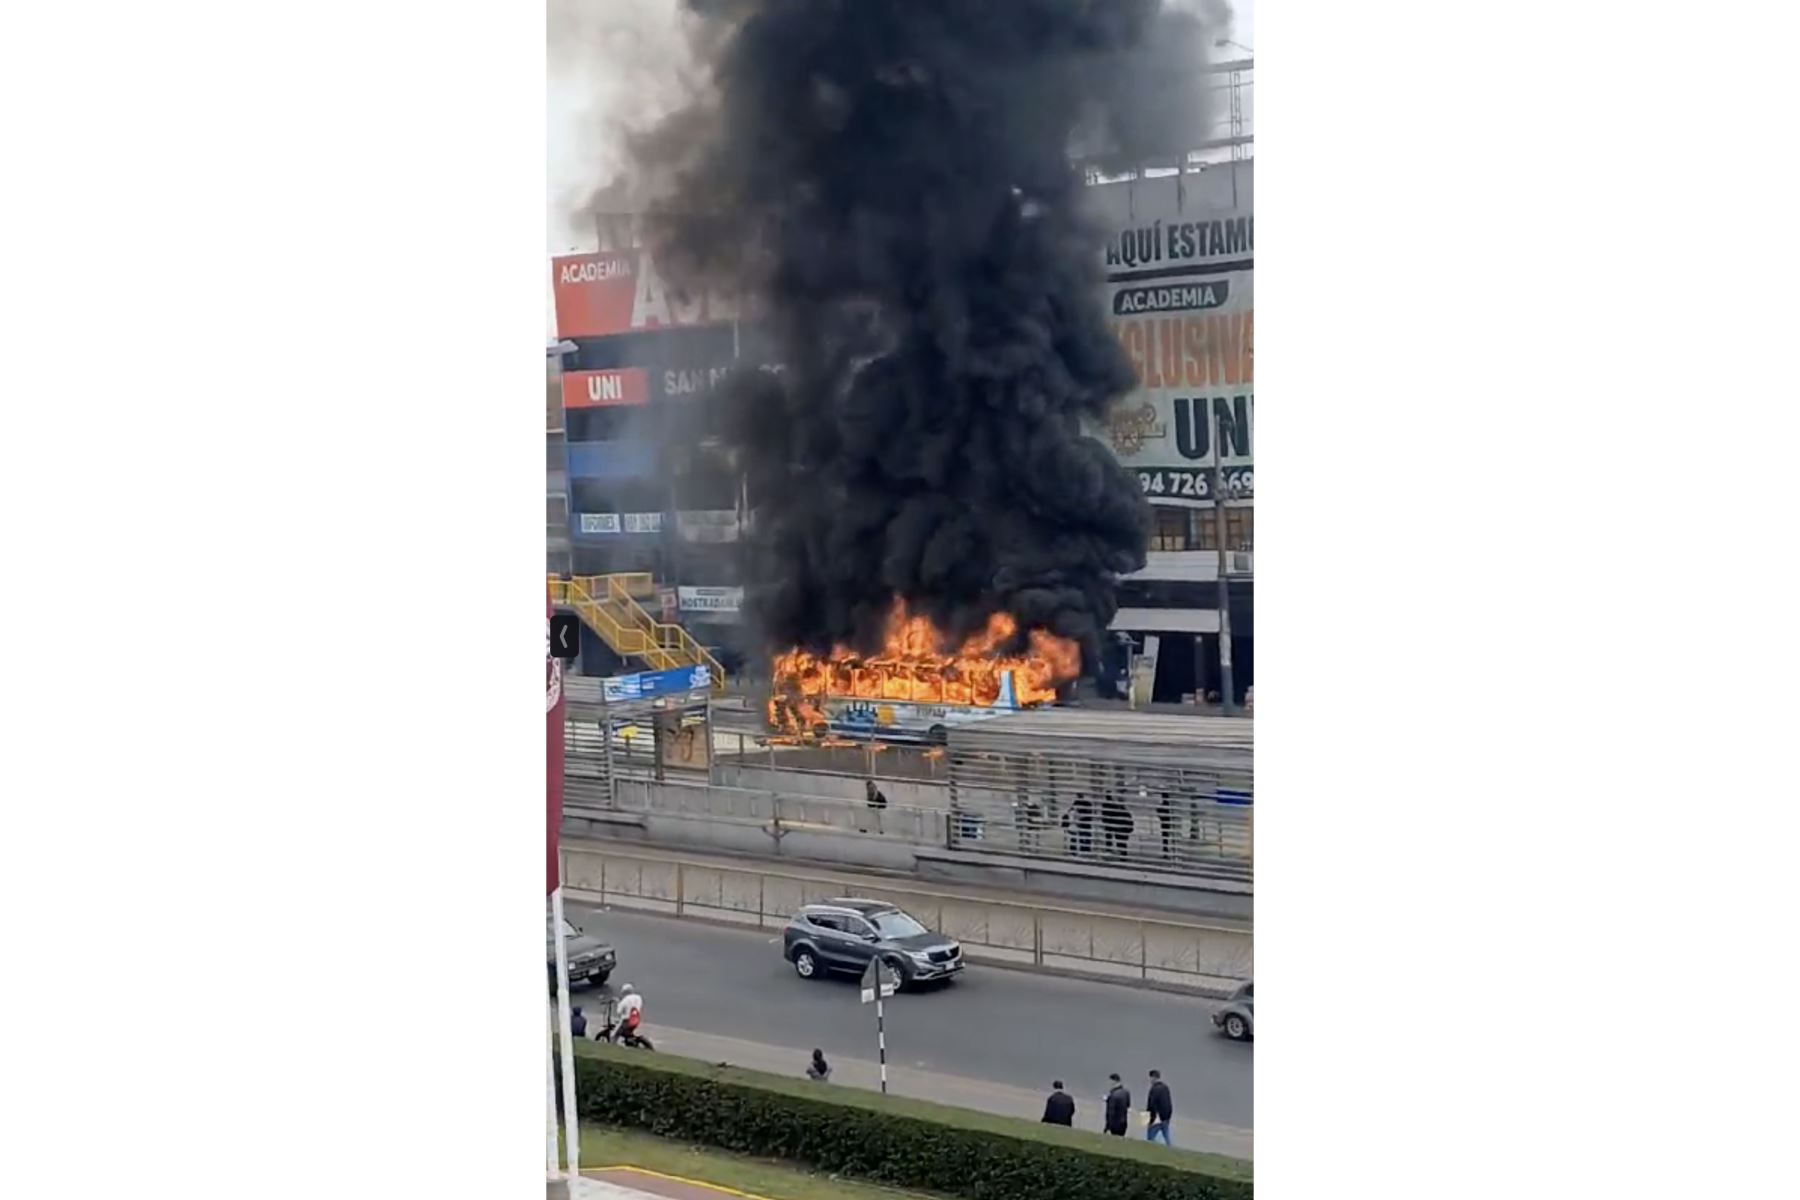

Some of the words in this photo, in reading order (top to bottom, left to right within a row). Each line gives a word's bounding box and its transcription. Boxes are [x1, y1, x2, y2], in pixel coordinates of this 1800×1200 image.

[1106, 219, 1161, 267] AQUÍ
[1168, 216, 1253, 259] ESTAM
[560, 261, 631, 283] ACADEMIA
[1121, 286, 1217, 312] ACADEMIA
[588, 375, 622, 401] UNI
[1174, 395, 1253, 460] UN
[1169, 473, 1208, 495] 726
